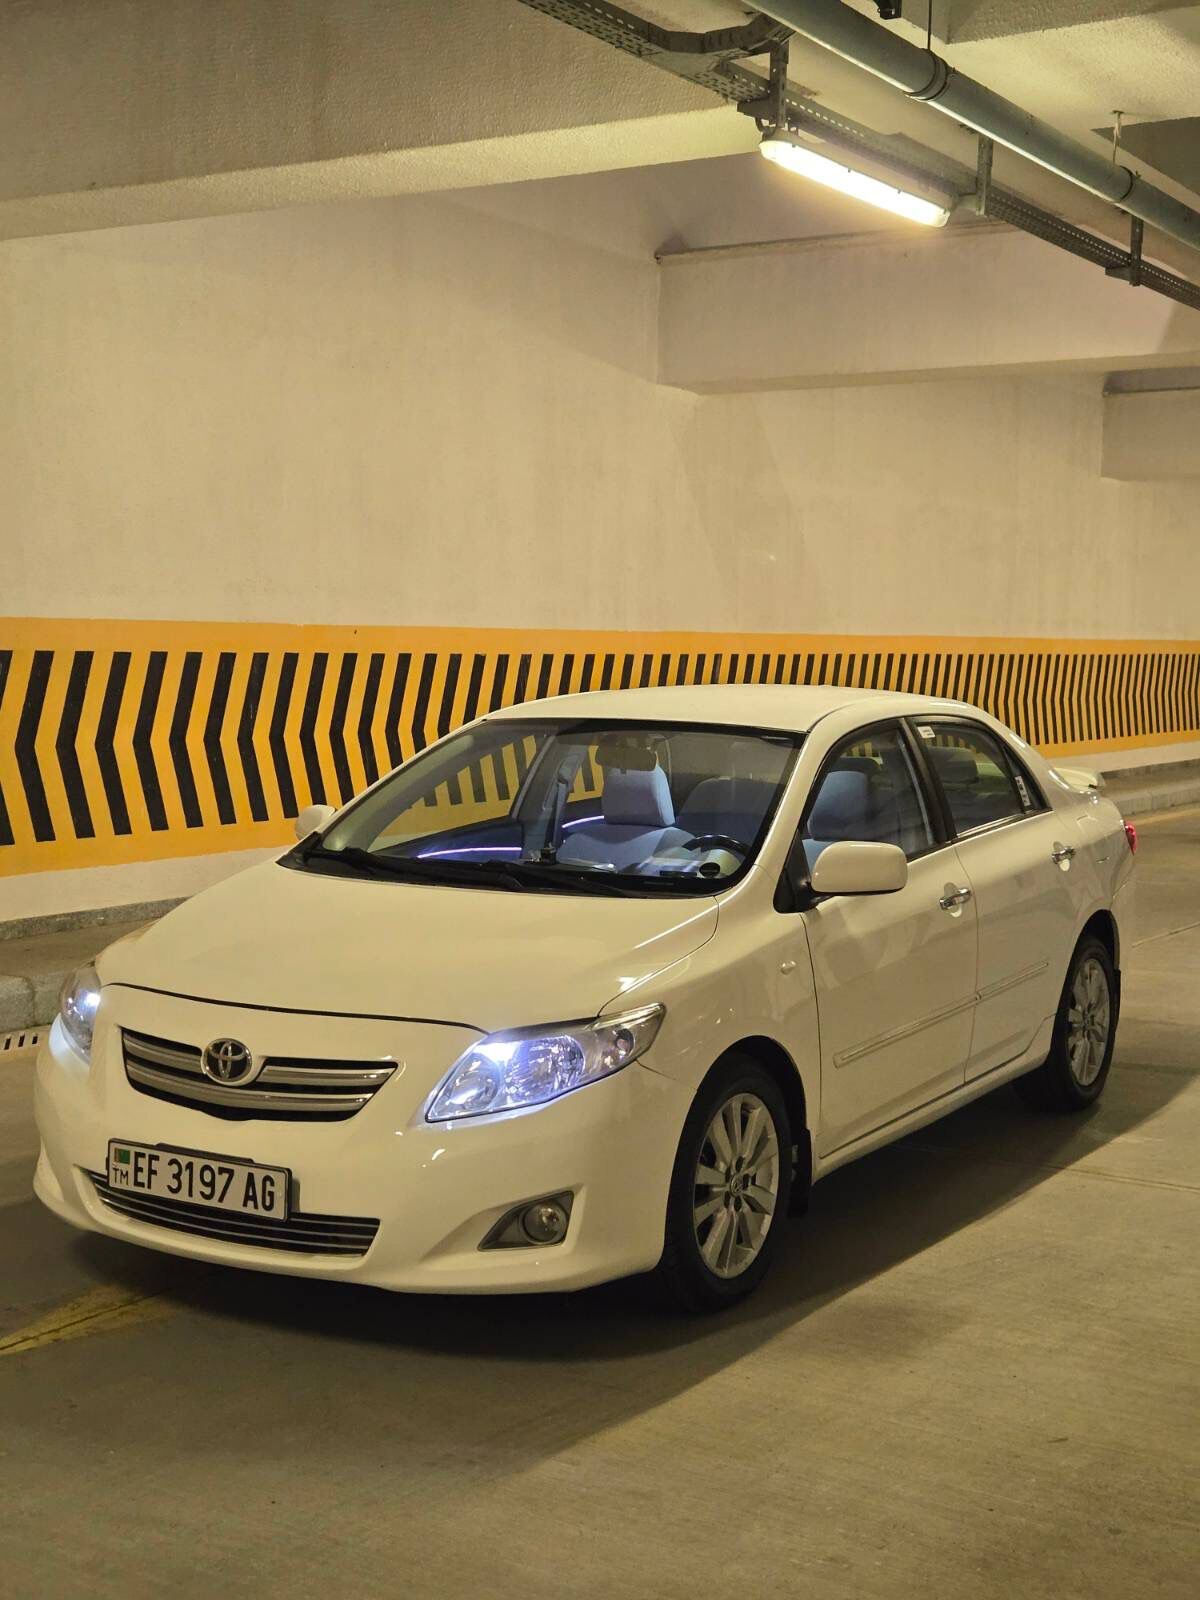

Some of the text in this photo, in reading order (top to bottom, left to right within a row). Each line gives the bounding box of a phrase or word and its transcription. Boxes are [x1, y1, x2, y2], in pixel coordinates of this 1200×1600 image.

[112, 1167, 129, 1186] TM
[133, 1151, 275, 1212] EF 3197 AG
